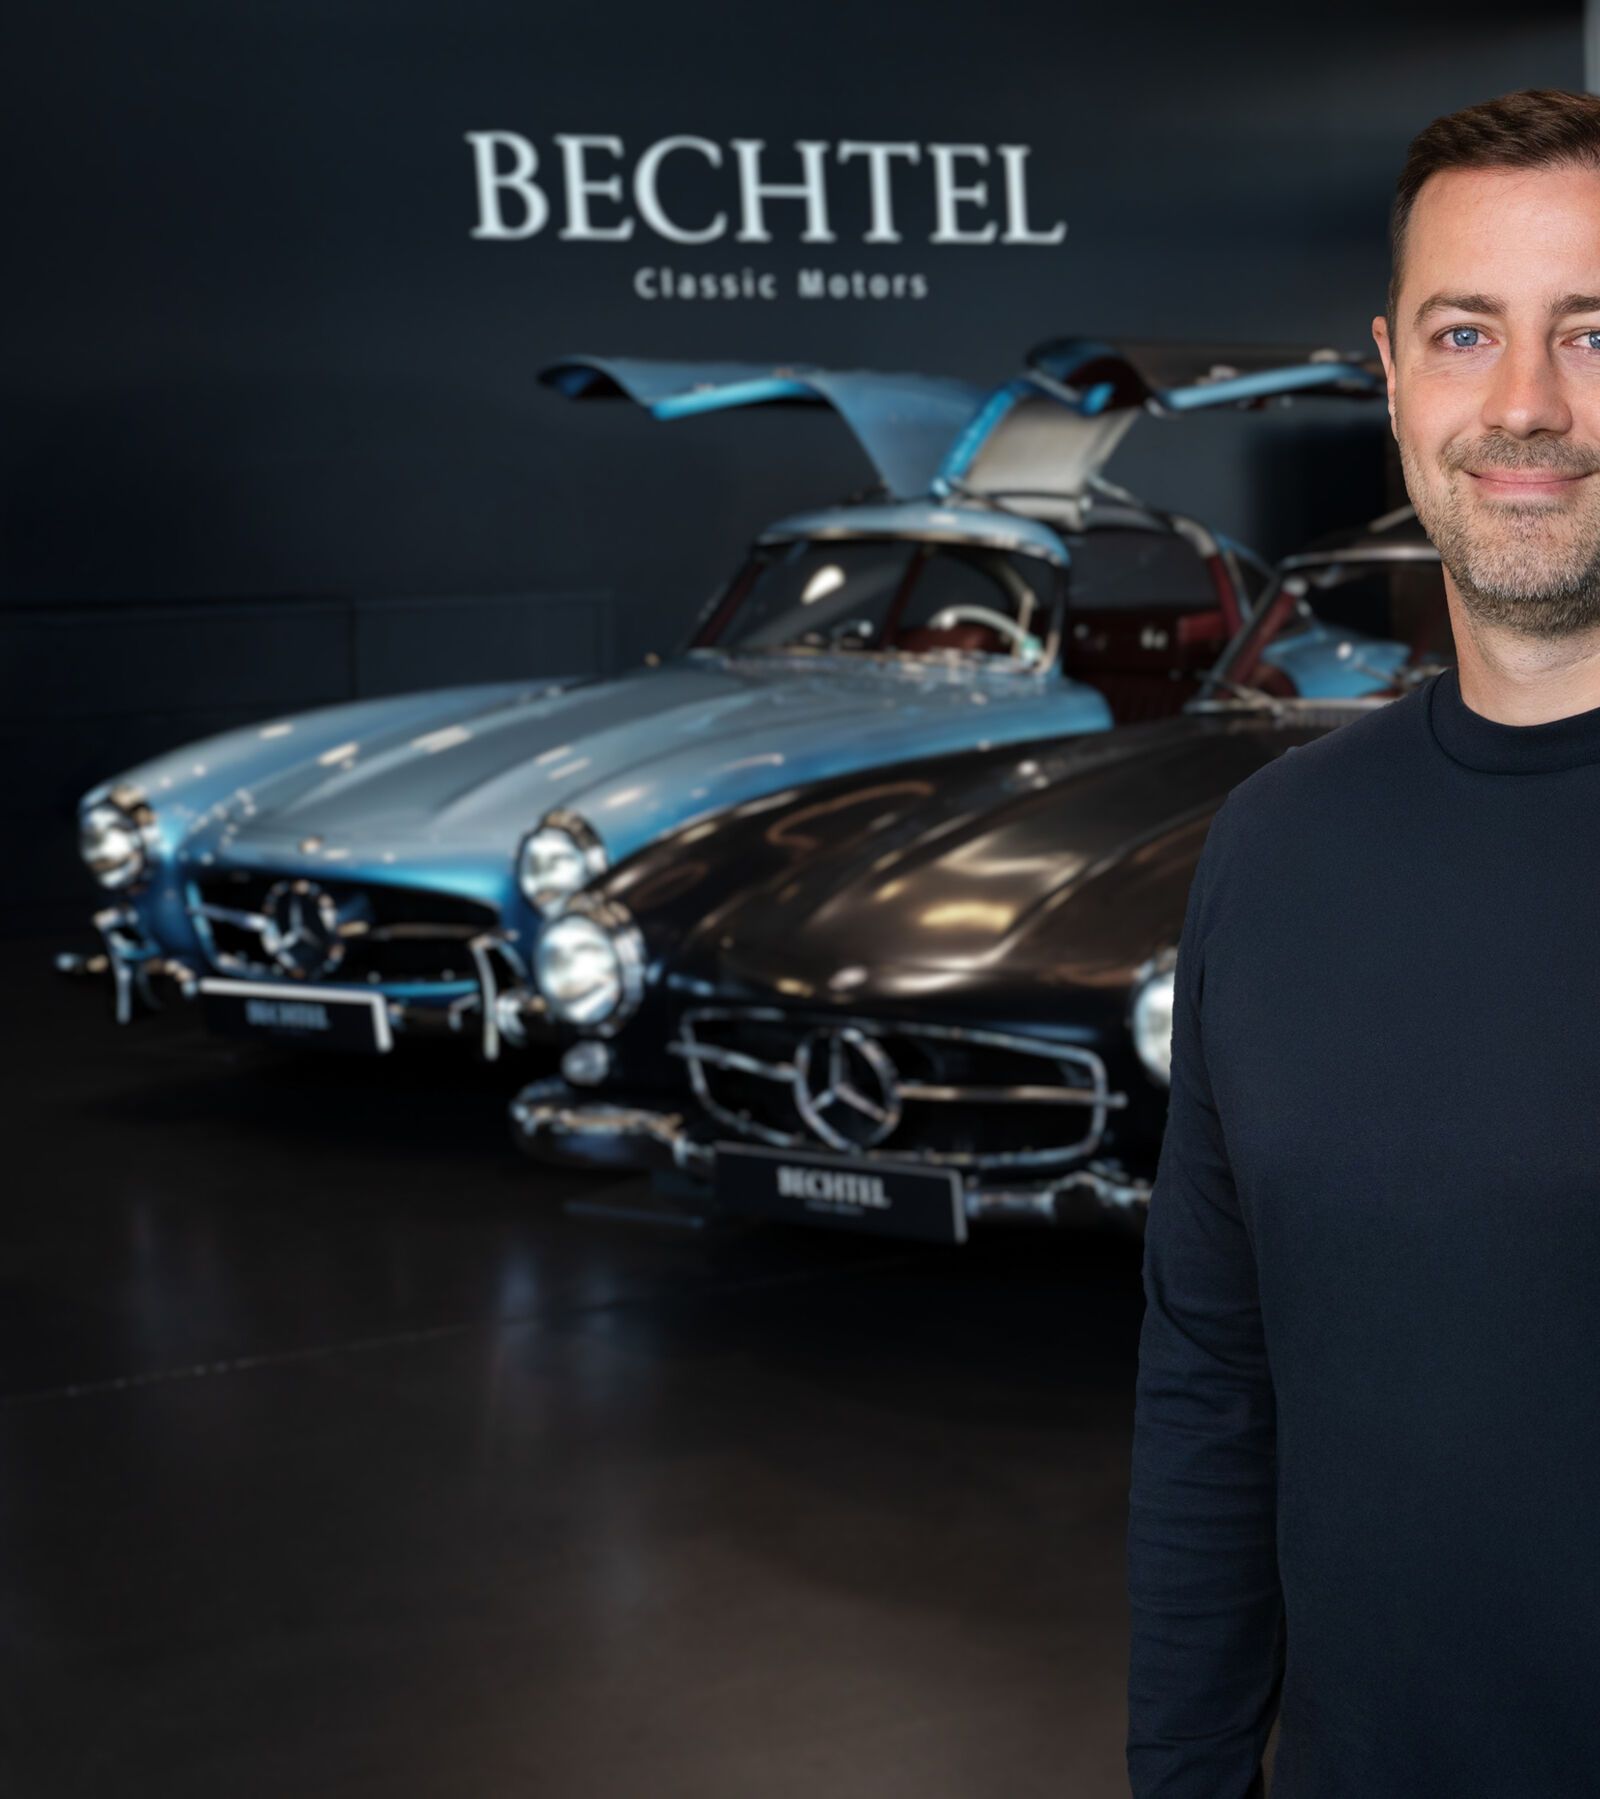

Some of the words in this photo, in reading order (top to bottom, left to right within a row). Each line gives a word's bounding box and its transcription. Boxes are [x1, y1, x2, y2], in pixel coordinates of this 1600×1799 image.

[465, 130, 1067, 245] BECHTEL
[633, 267, 776, 300] Classic
[797, 268, 928, 300] Motors
